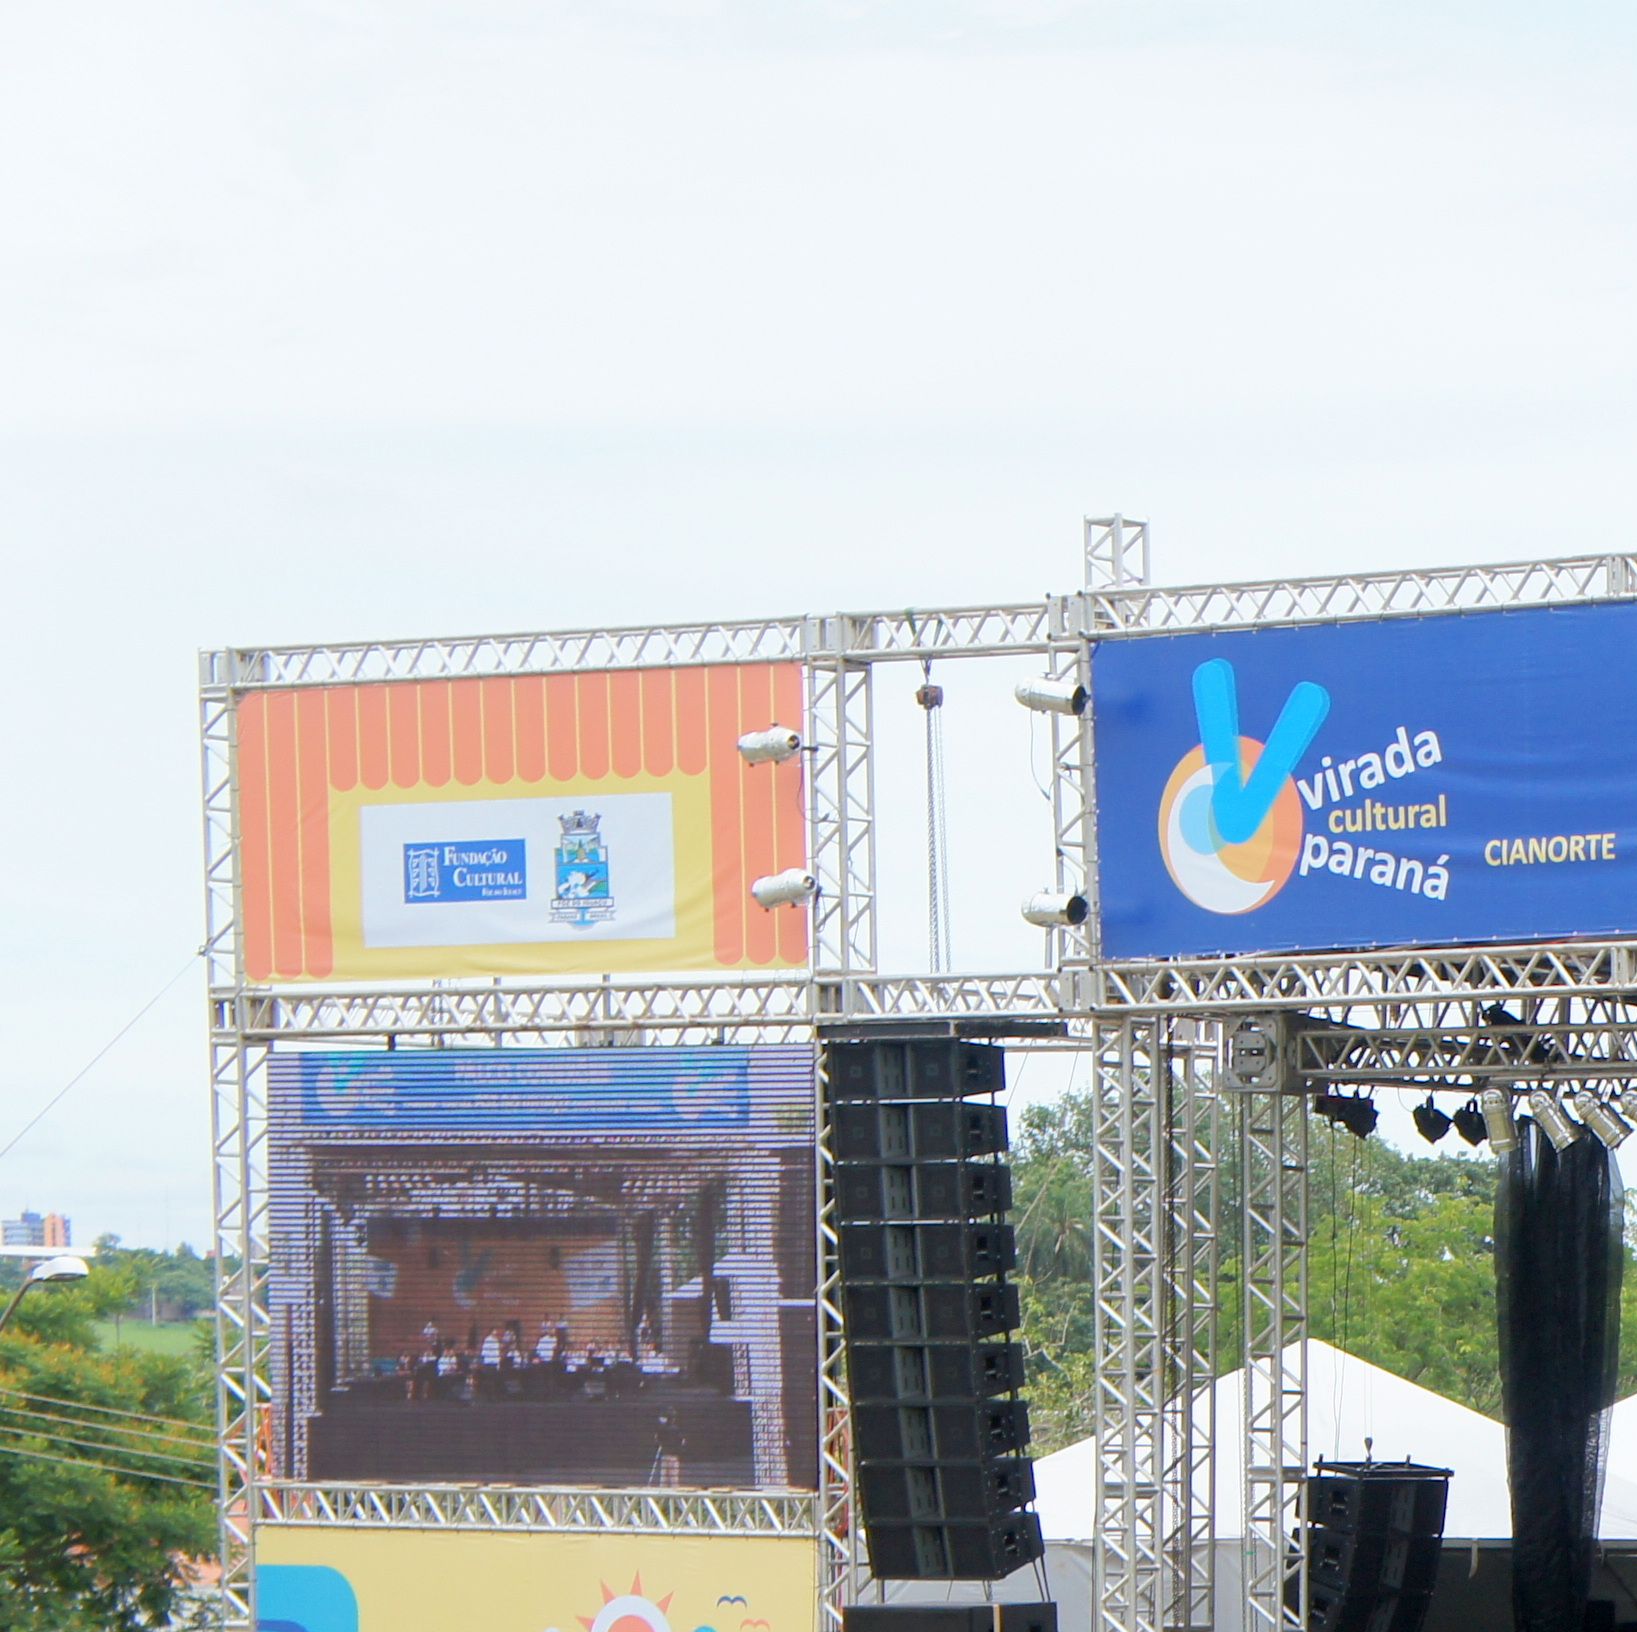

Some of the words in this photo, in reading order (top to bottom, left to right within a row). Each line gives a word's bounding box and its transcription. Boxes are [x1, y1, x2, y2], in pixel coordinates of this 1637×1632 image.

[1296, 725, 1443, 812] virada
[1328, 793, 1447, 834] cultural
[1298, 832, 1451, 901] paraná
[1483, 831, 1617, 867] CIANORTE
[453, 867, 523, 887] CULTURAL
